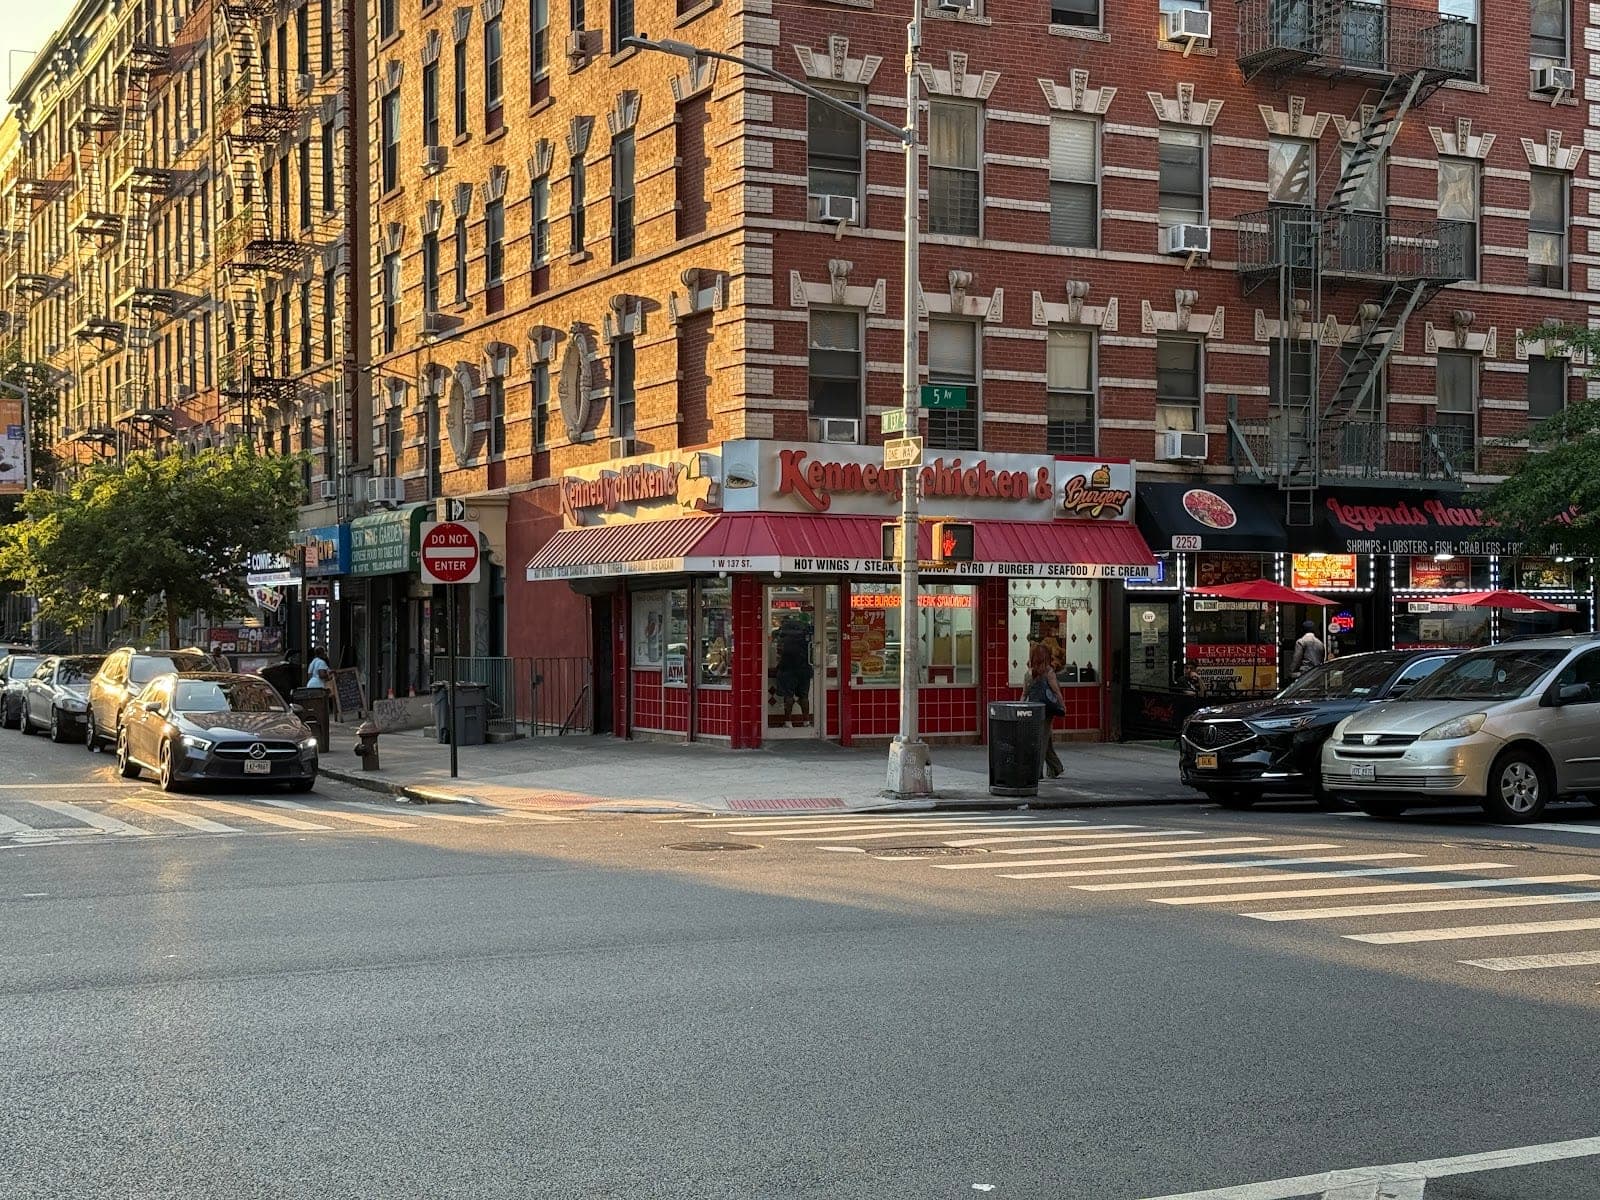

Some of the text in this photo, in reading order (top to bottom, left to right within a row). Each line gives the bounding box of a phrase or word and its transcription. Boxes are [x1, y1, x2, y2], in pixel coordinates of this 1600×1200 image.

[933, 388, 952, 404] 5 Av
[890, 412, 899, 431] 137
[888, 446, 913, 460] ONE WAY
[779, 449, 1053, 512] Kenned chicken &
[559, 461, 677, 526] Kennedy chicken &
[1064, 475, 1131, 518] Burgers
[1327, 497, 1428, 532] Legends
[352, 530, 364, 548] NEW
[379, 523, 403, 545] GARDEN
[431, 534, 468, 544] DO NOT
[1175, 536, 1198, 549] 2252
[1346, 539, 1381, 553] SHRIMPS
[1388, 540, 1428, 554] LOBSTERS
[1435, 540, 1453, 554] FISH
[1460, 541, 1480, 554] CRAB
[1481, 541, 1501, 555] LEGS
[434, 560, 466, 571] ENTER
[659, 559, 674, 570] CREAM
[718, 560, 726, 568] W
[727, 560, 740, 568] 137
[741, 560, 753, 569] ST.
[794, 558, 813, 570] HOT
[816, 559, 850, 571] WINGS
[864, 560, 894, 572] STEAK
[960, 563, 984, 575] GYRO
[999, 564, 1034, 575] BURGER
[1047, 564, 1088, 576] SEAFOOD
[1101, 565, 1115, 577] ICE
[1118, 566, 1149, 577] CREAM
[850, 595, 875, 608] HEESE
[937, 595, 971, 608] SANDWICH
[1331, 616, 1355, 629] OPEN
[668, 665, 684, 677] ATM
